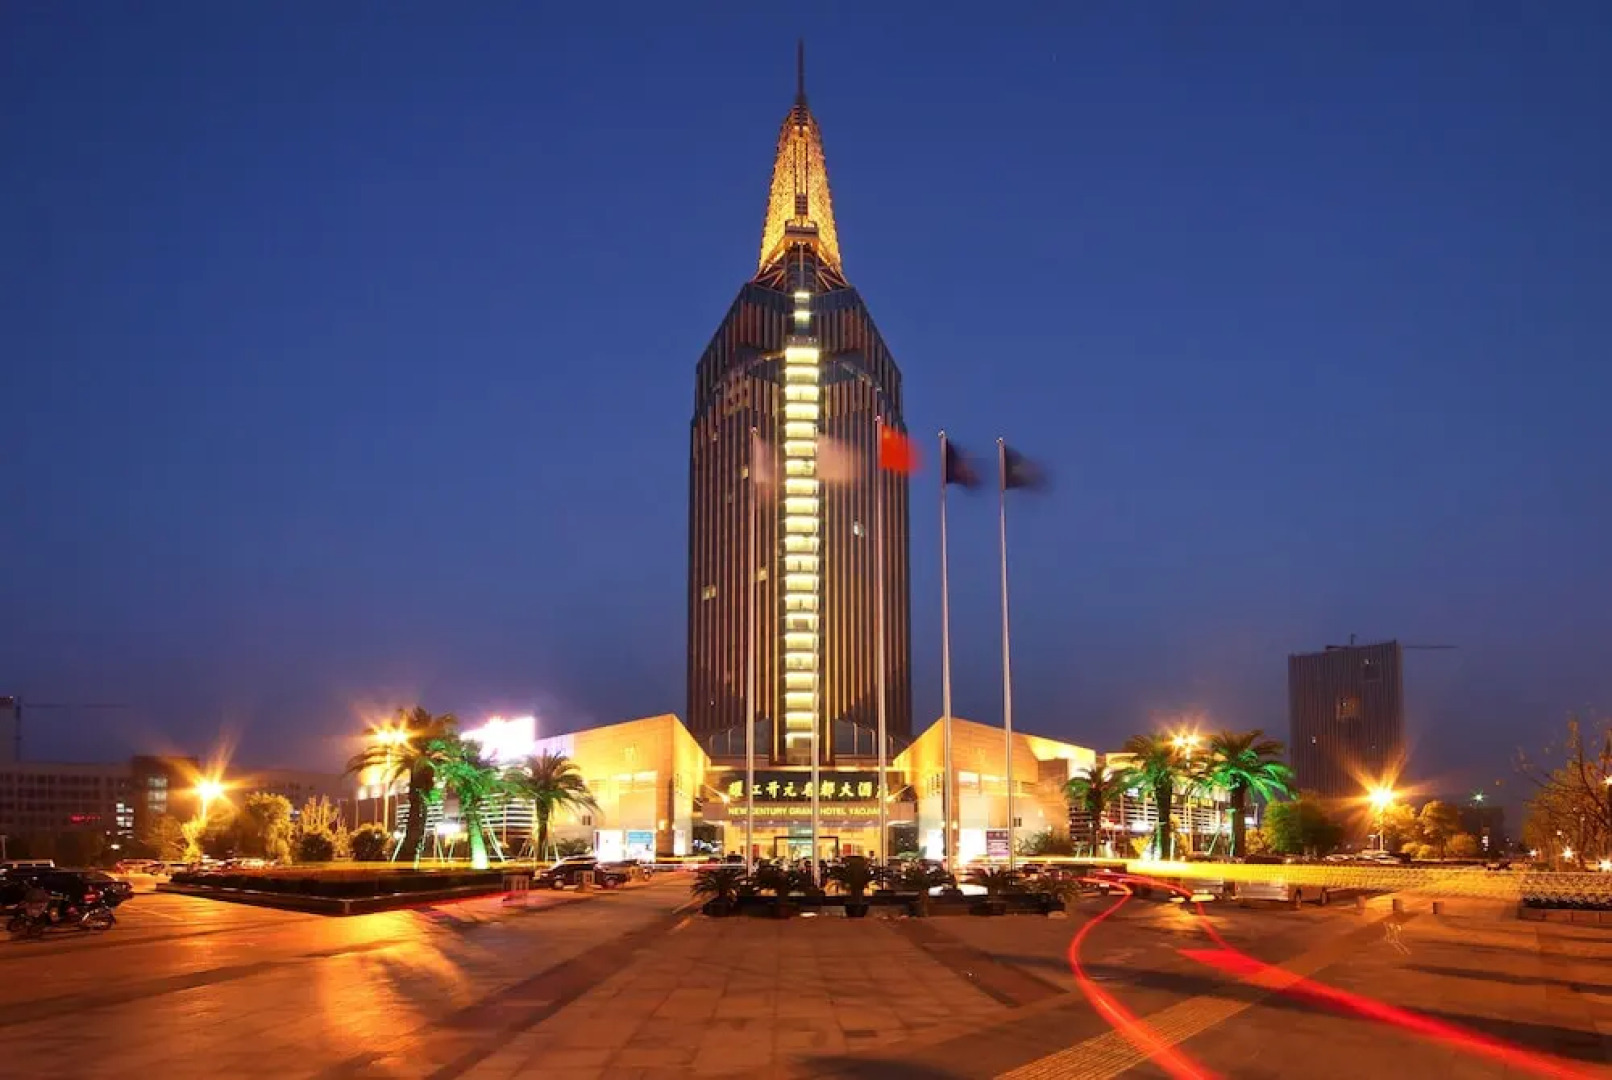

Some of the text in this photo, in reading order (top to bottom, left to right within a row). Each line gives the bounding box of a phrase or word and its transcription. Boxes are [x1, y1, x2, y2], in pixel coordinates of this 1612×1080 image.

[728, 807, 747, 815] NEW
[790, 807, 815, 815] GRAN
[819, 807, 846, 815] HOTEL
